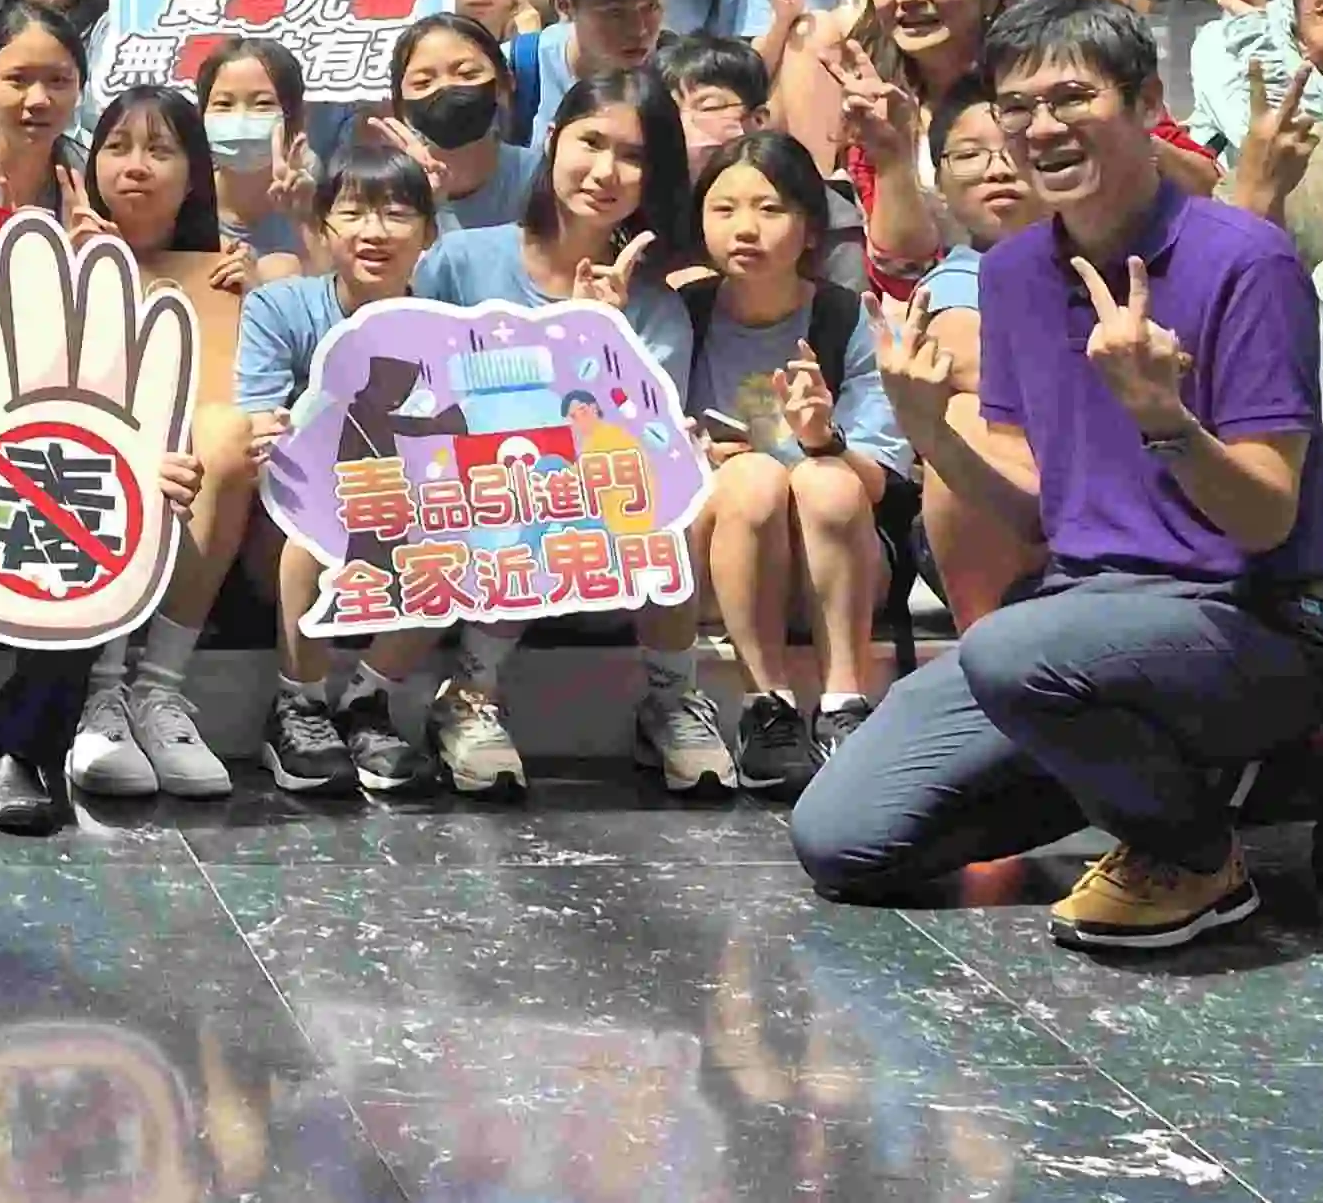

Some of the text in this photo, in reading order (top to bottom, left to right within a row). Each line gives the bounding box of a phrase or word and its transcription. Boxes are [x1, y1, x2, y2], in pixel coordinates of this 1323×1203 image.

[334, 449, 651, 540] 毒品引進門
[332, 528, 684, 626] 全家近鬼門
